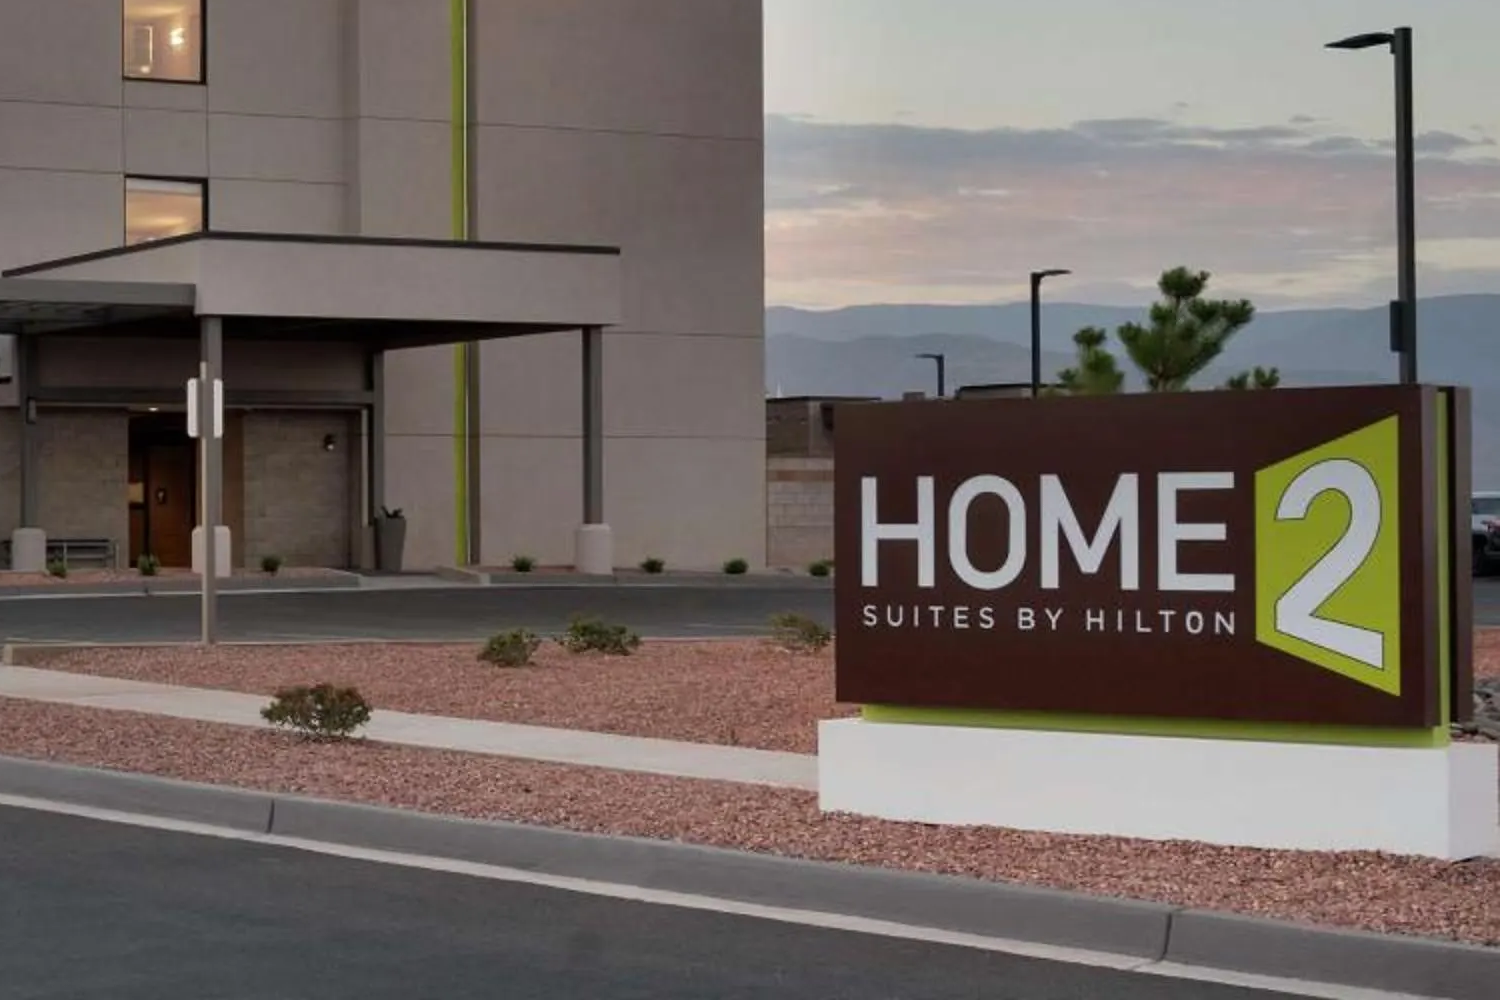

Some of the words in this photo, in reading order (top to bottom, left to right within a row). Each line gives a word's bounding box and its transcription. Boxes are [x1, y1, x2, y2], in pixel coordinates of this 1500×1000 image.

[860, 472, 1236, 592] HOME
[1273, 457, 1384, 671] 2
[862, 604, 995, 629] SUITES
[1017, 607, 1064, 632] BY
[1086, 608, 1236, 635] HILTON
